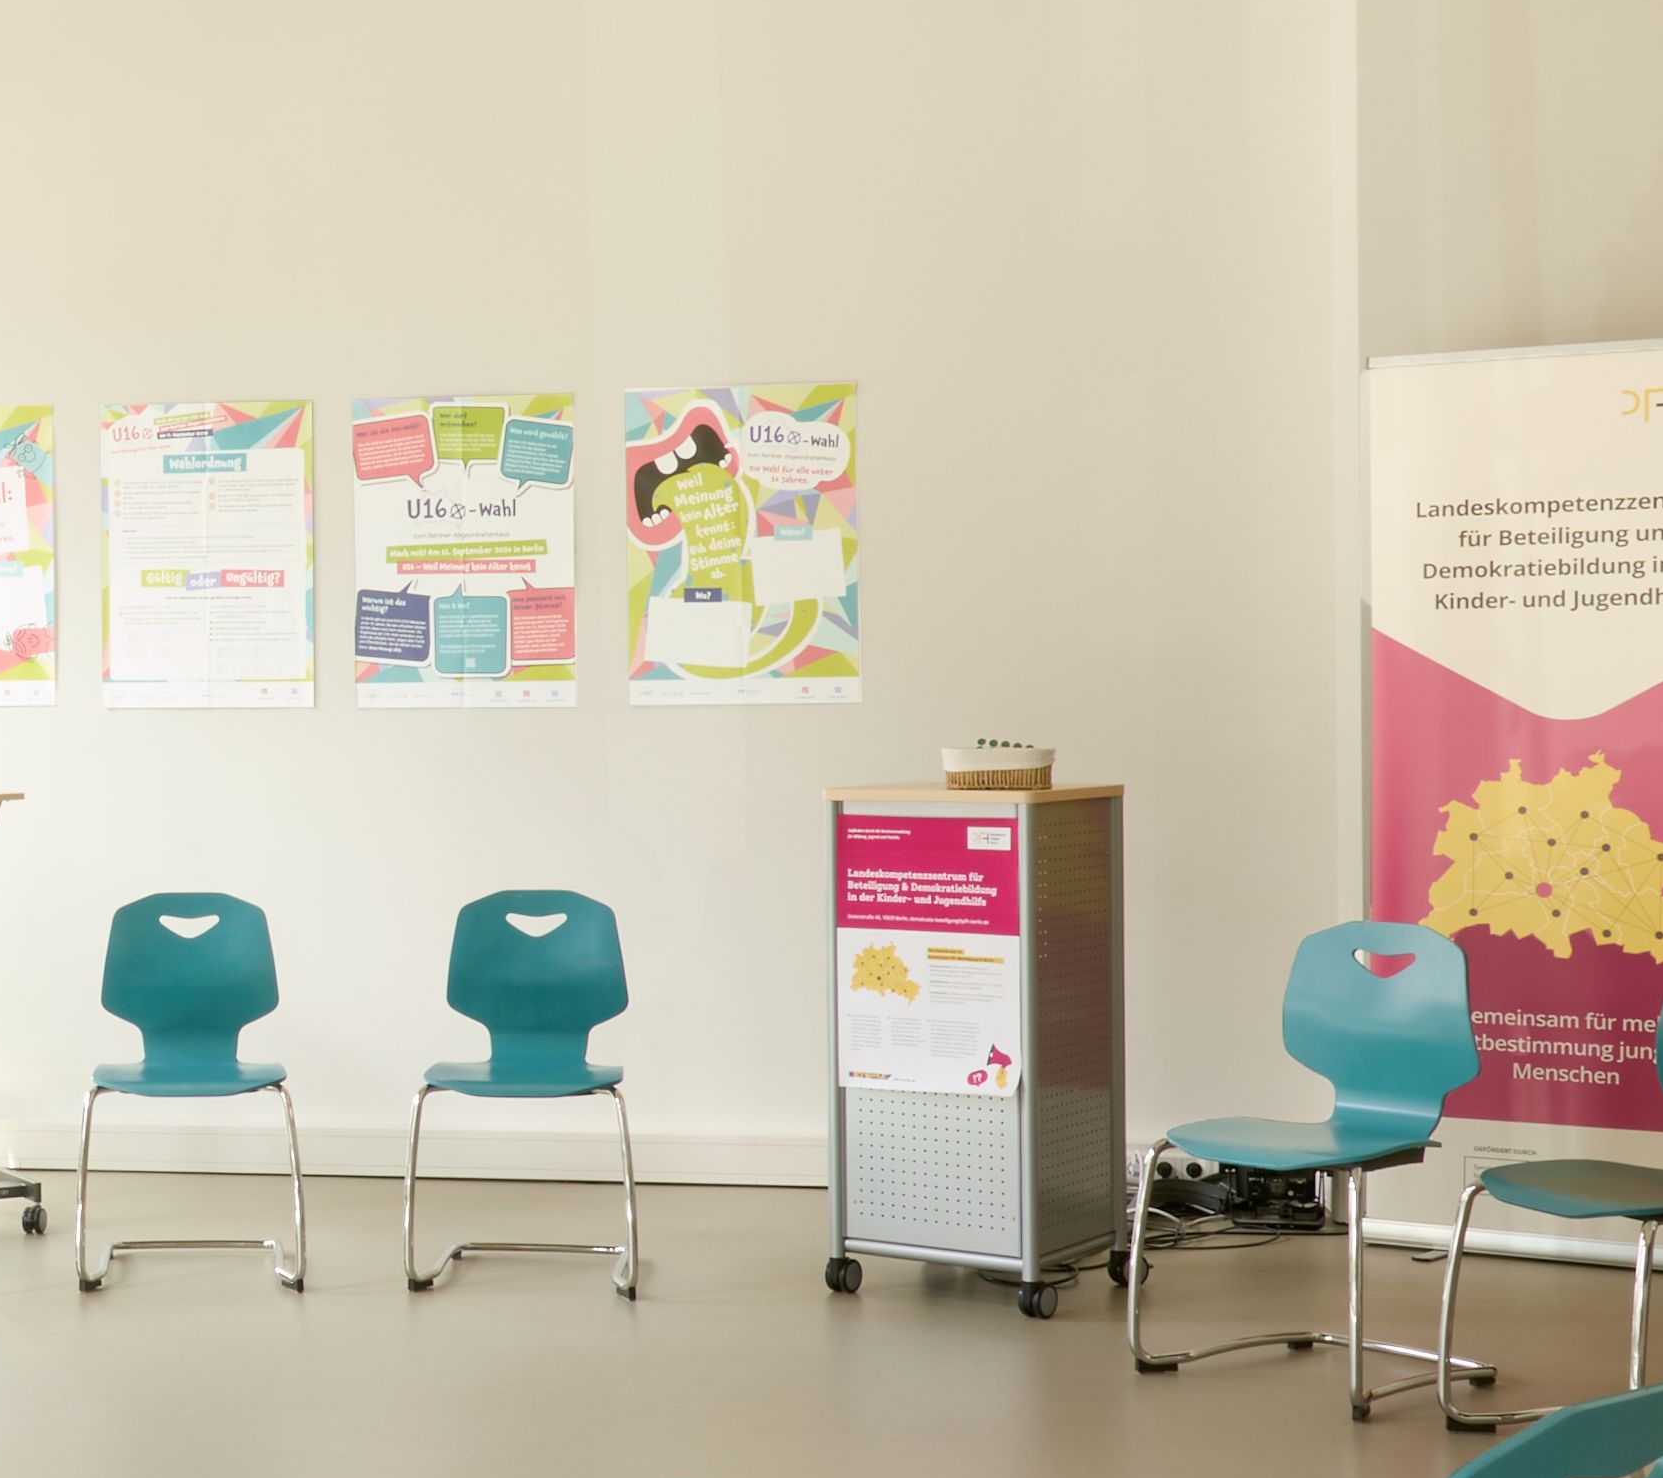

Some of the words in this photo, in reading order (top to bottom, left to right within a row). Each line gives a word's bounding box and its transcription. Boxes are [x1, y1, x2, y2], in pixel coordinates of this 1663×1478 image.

[113, 426, 140, 442] U16
[750, 426, 784, 443] U16
[169, 456, 242, 471] Wahlordnung
[676, 472, 702, 490] Weil
[674, 486, 733, 507] Meinung
[407, 499, 447, 519] U16
[680, 510, 702, 522] kein
[703, 502, 738, 521] Alter
[696, 520, 735, 538] kennt:
[1458, 528, 1492, 548] für
[1498, 524, 1629, 549] Beteiligung
[522, 544, 544, 553] Berlin
[709, 537, 741, 550] deine
[440, 562, 470, 572] Meinung
[488, 561, 508, 570] Alter
[690, 553, 738, 571] Stimme
[1422, 556, 1646, 580] Demokratiebildung
[146, 572, 183, 586] Gültig
[190, 575, 217, 588] oder
[226, 571, 280, 587] Ungültig?
[695, 591, 711, 600] Wo?
[1434, 590, 1516, 611] Kinder-
[1522, 589, 1566, 608] und
[362, 604, 389, 614] wichtig?
[969, 872, 984, 882] für
[847, 880, 899, 893] Beteiligung
[847, 892, 857, 902] in
[859, 892, 875, 903] der
[914, 895, 932, 905] und
[933, 895, 987, 907] Jugendhilfe
[1471, 1010, 1581, 1031] emeinsam
[1585, 1010, 1617, 1031] für
[1474, 1034, 1613, 1062] tbestimmung
[1513, 1063, 1621, 1086] Menschen
